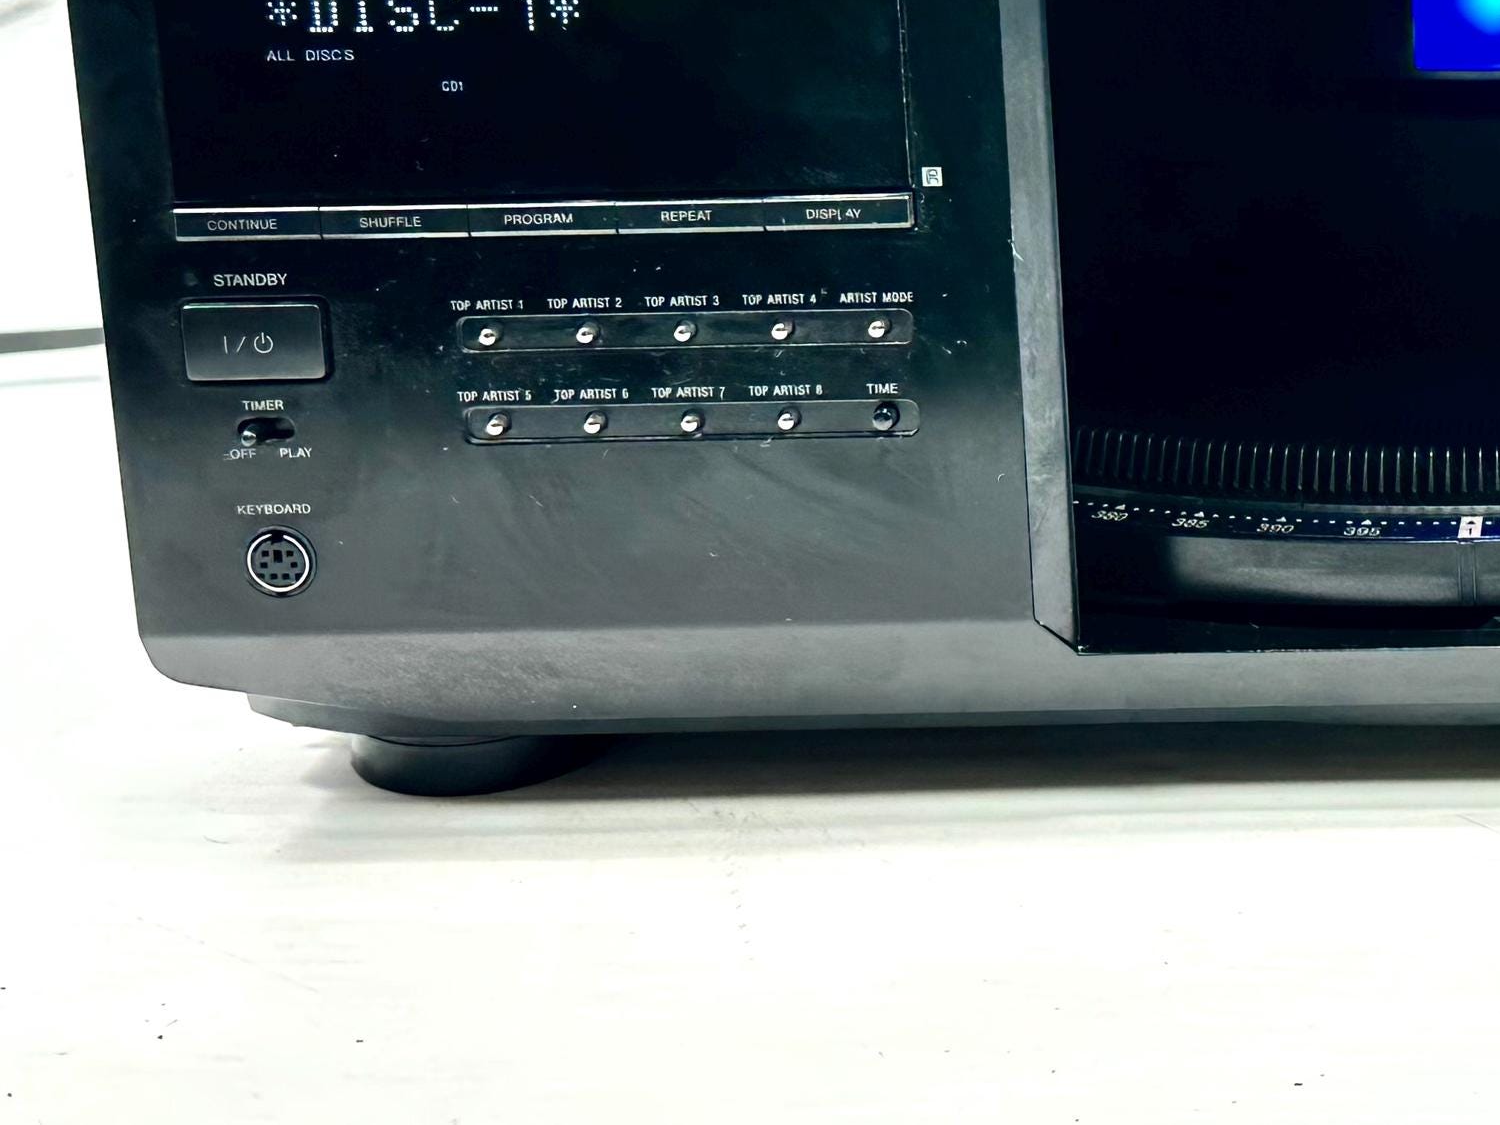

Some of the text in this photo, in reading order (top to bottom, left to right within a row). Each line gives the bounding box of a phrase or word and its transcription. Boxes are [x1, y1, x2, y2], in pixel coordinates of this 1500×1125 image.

[266, 48, 355, 63] ALL DISCS
[504, 212, 574, 227] PROGRAM
[659, 209, 713, 224] REPEAT
[805, 207, 863, 222] DISPLAY
[207, 217, 278, 232] CONTINUE
[359, 215, 422, 230] SHUFFLE
[213, 273, 288, 287] STANDBY
[547, 297, 623, 309] TOP ARTIST 2
[644, 295, 720, 307] TOP ARTIST 3
[742, 293, 817, 306] TOP ARTIST 4
[839, 291, 914, 304] ARTIST MODE
[450, 299, 524, 311] TOP ARTIST 1
[556, 388, 629, 400] TOP ARTIST 6
[651, 386, 726, 399] TOP ARTIST 7
[748, 384, 823, 396] TOP ARTIST 8
[866, 383, 899, 395] TIME
[457, 390, 532, 402] TOP ARTIST 5
[241, 400, 284, 411] TIMER
[230, 448, 257, 460] OFF
[279, 447, 312, 459] PLAY
[237, 504, 311, 515] KEYBOARD
